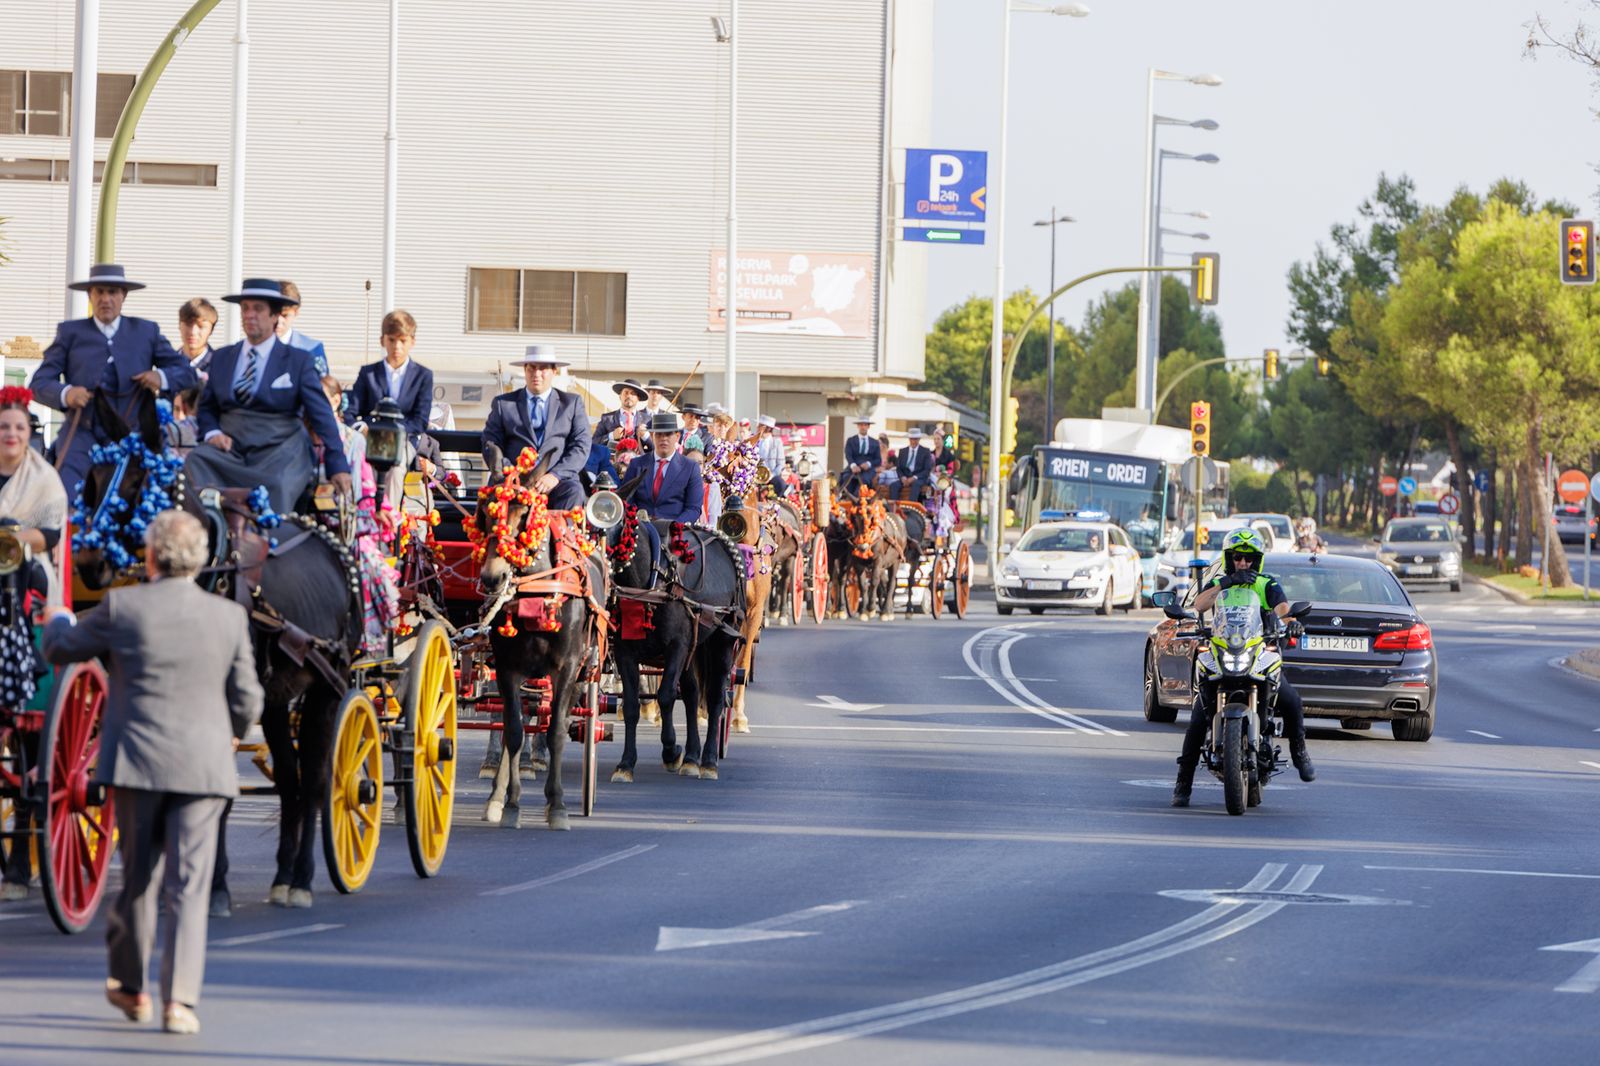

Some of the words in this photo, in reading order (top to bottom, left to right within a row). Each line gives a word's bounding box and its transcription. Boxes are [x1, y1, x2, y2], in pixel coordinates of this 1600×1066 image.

[929, 154, 963, 202] P
[940, 190, 959, 203] 24h
[717, 257, 772, 271] RSERVA
[745, 273, 797, 286] TELPARK
[736, 288, 784, 300] SEVILLA
[1051, 457, 1090, 478] RMEN
[1311, 637, 1339, 649] 3112
